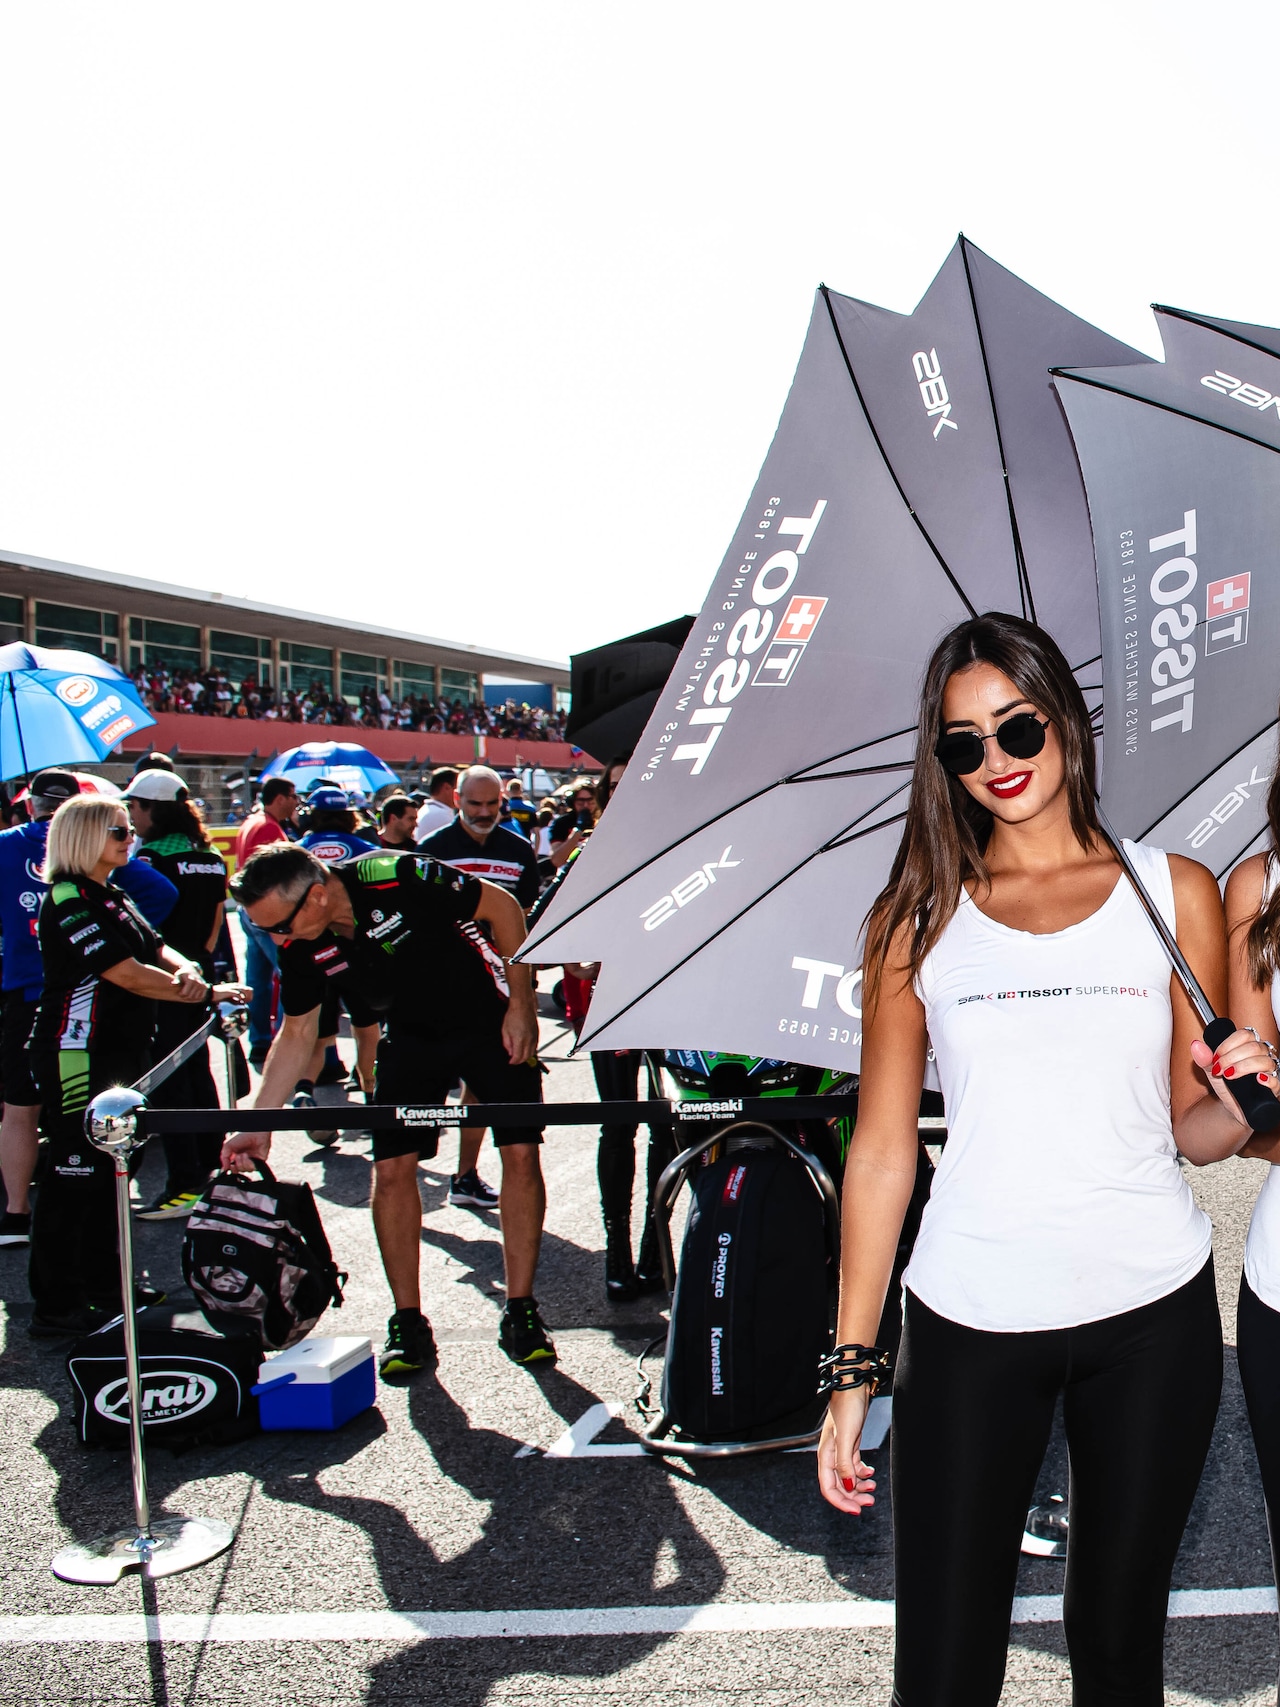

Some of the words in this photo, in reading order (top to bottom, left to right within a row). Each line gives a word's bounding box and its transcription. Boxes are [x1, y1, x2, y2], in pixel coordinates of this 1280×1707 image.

[366, 911, 403, 939] Kawasaki
[1017, 987, 1073, 998] TISSOT
[1075, 986, 1149, 998] SUPERPOLE
[396, 1106, 468, 1119] Kawasaki
[671, 1099, 743, 1113] Kawasaki
[404, 1119, 435, 1127] Racing
[679, 1113, 710, 1121] Racing
[714, 1247, 728, 1298] PROVEC
[711, 1327, 724, 1395] Kawasaki
[142, 1407, 178, 1418] ELMET
